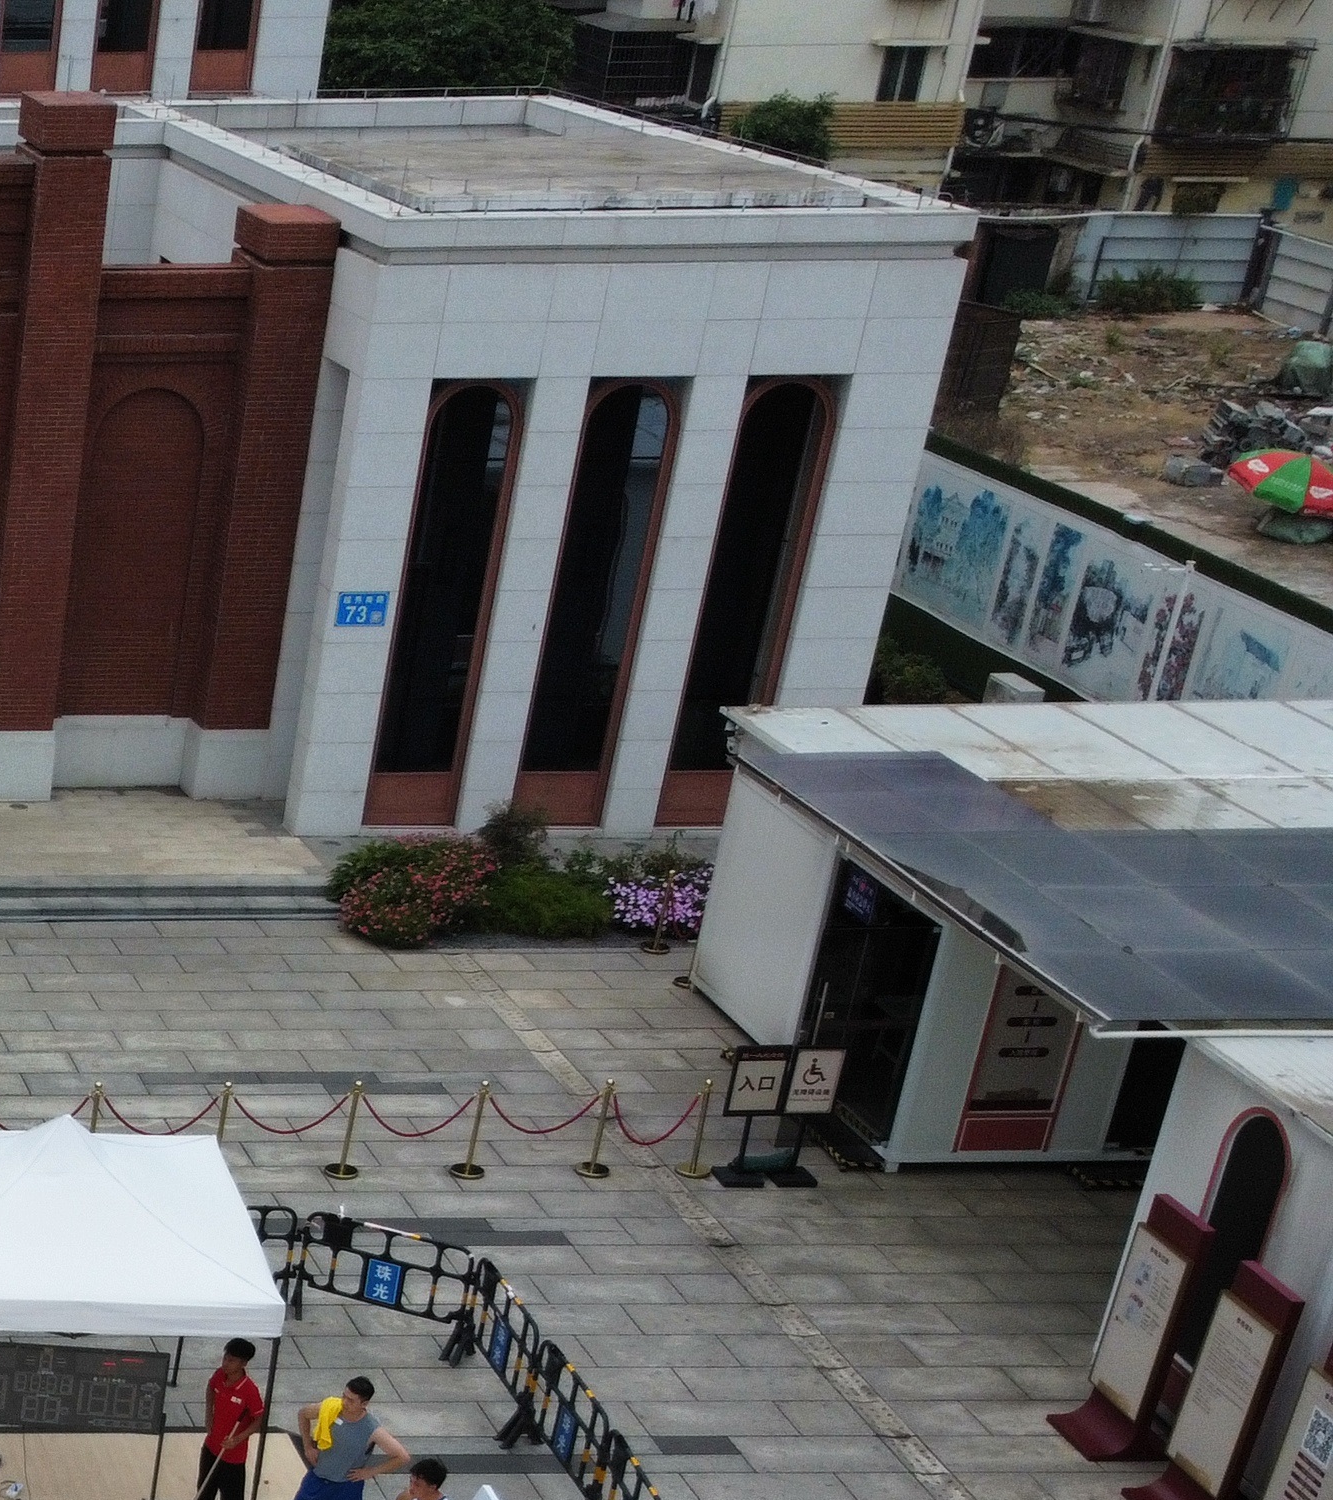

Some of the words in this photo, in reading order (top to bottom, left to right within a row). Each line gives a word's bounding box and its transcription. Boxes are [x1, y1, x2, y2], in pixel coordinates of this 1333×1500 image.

[345, 605, 367, 623] 73
[738, 1076, 775, 1091] 入口
[372, 1264, 392, 1300] 珠光
